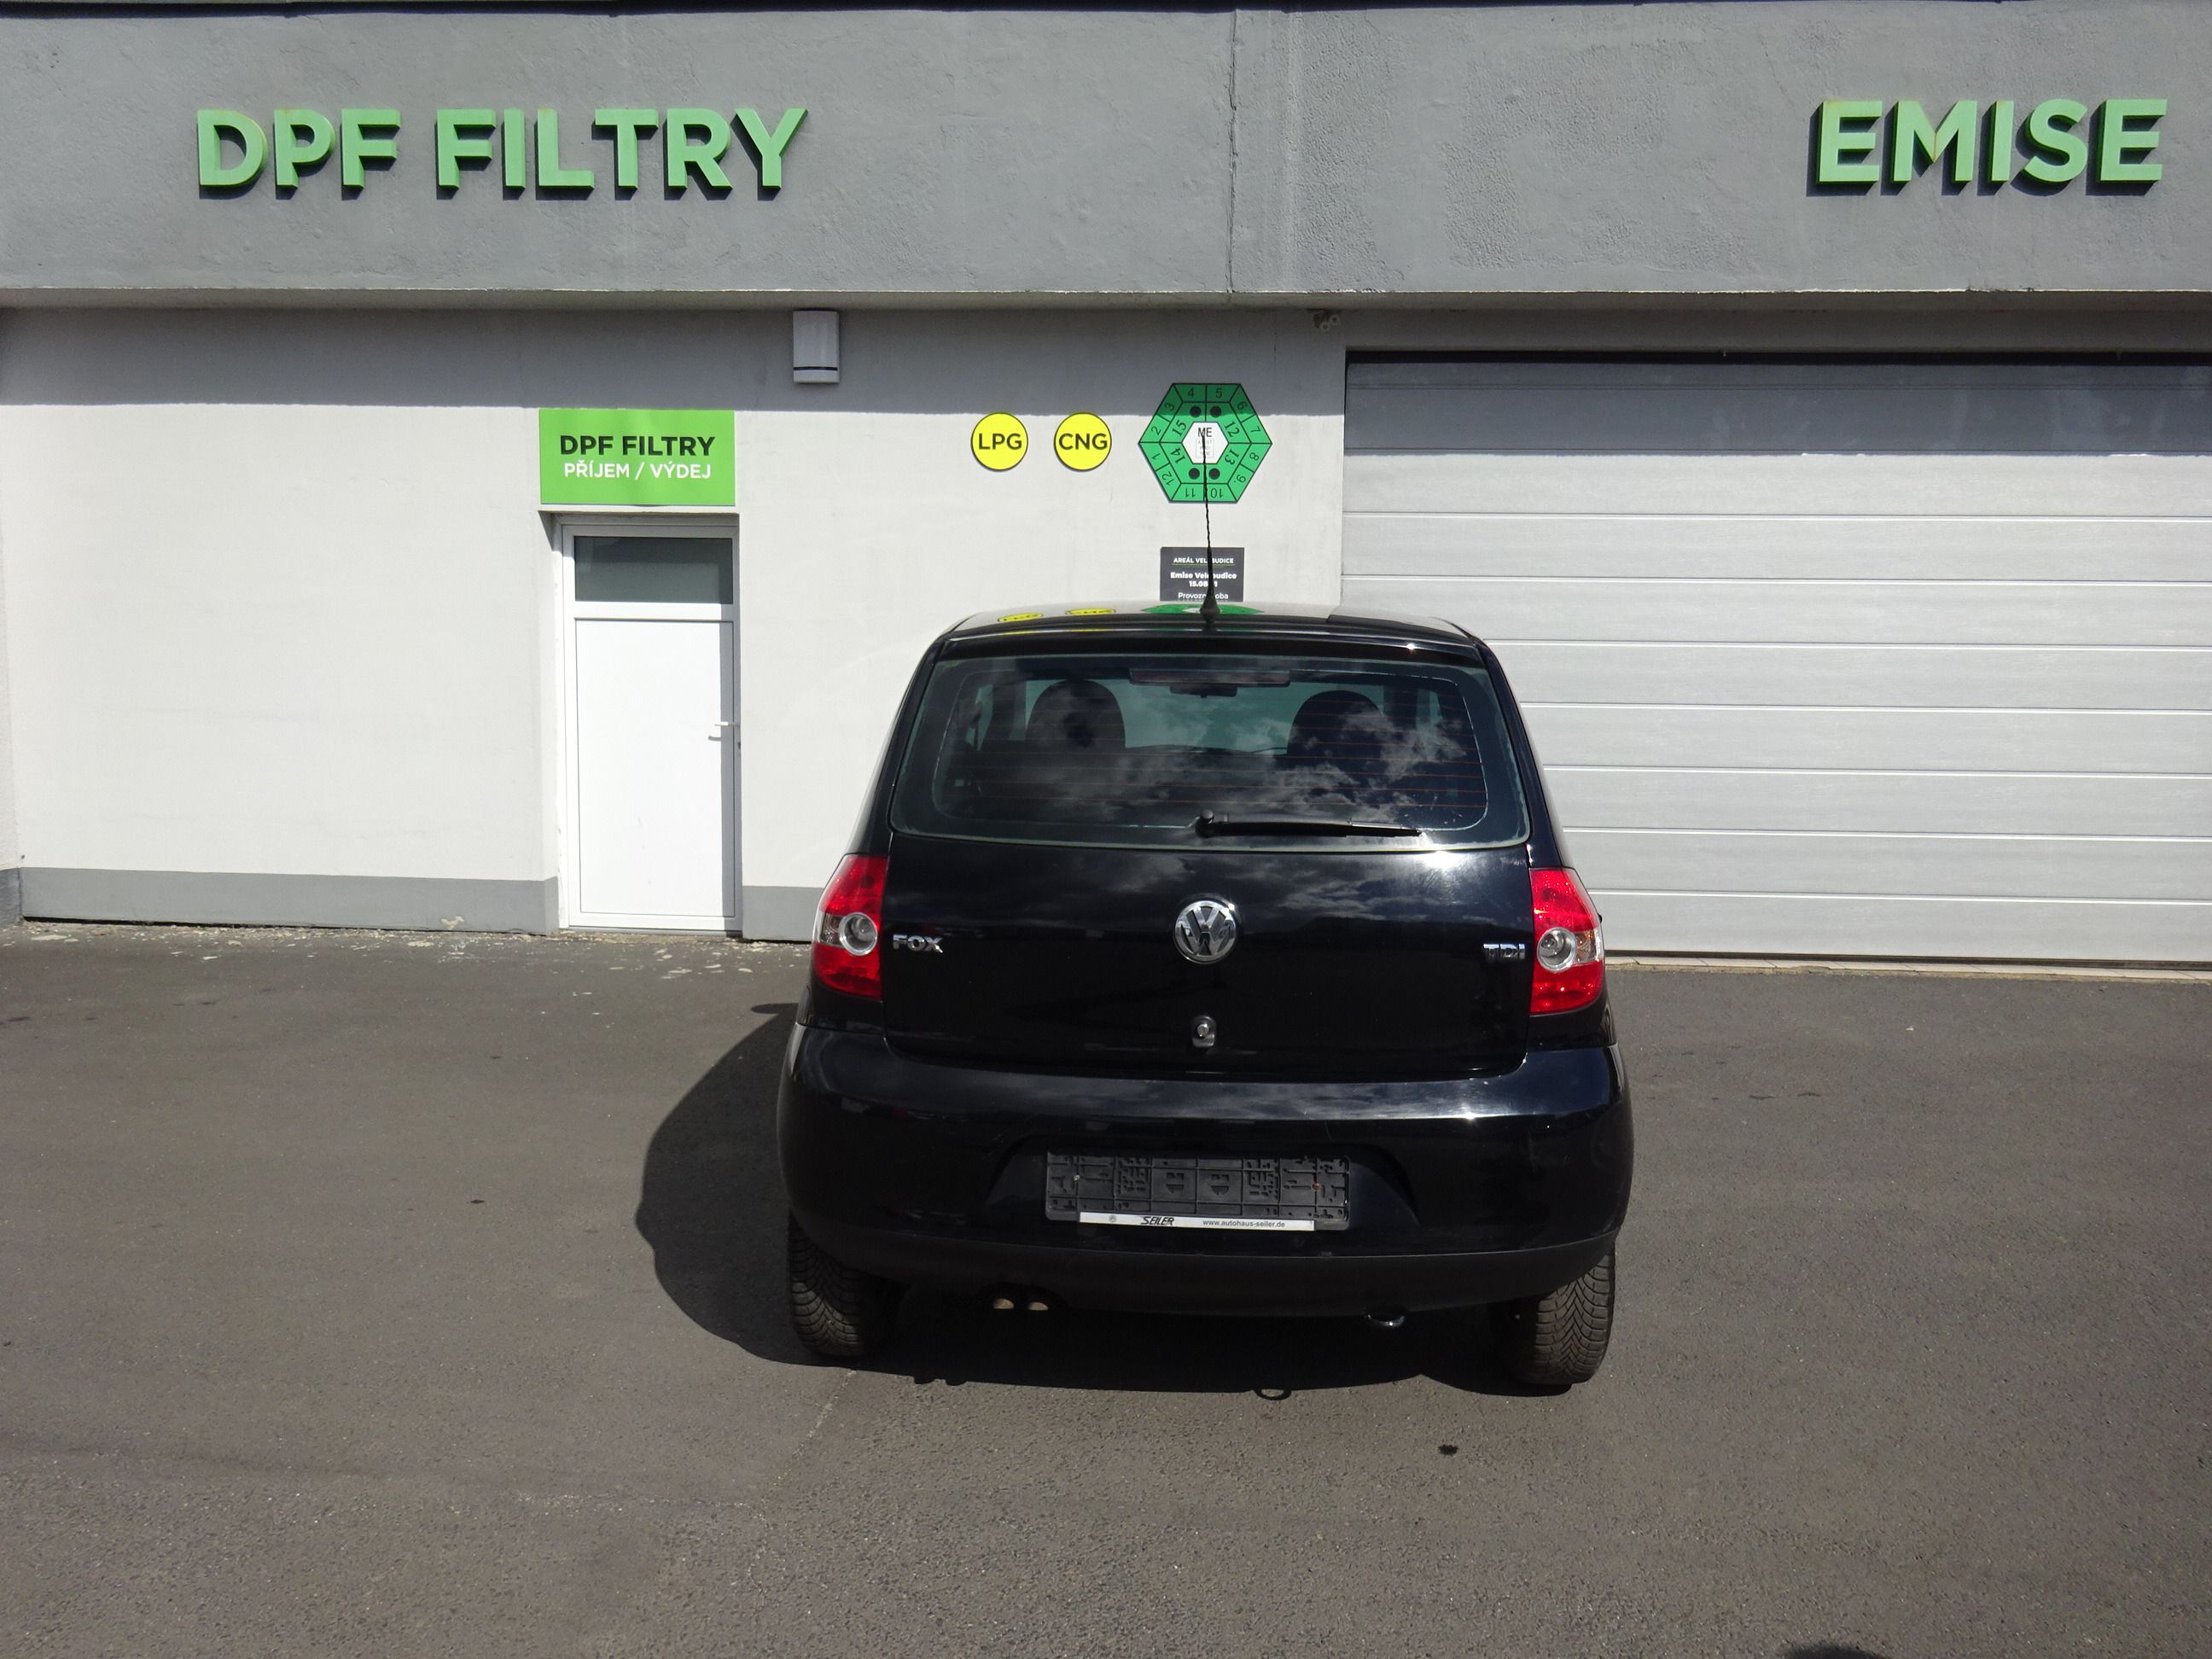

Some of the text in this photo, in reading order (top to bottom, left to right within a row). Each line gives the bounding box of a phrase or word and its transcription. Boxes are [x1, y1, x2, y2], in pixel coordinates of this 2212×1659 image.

[196, 108, 808, 188] DPF FILTRY
[1815, 98, 2168, 185] EMISE
[1187, 387, 1195, 398] 4
[1215, 387, 1223, 399] 5
[1164, 402, 1175, 411] 3
[1151, 426, 1161, 436] 2
[1172, 419, 1187, 436] 15
[1197, 427, 1213, 438] ME
[1224, 422, 1240, 438] 12
[560, 435, 716, 456] DPF FILTRY
[978, 433, 1022, 451] LPG
[1058, 433, 1108, 451] CNG
[1170, 447, 1185, 464] 14
[1225, 449, 1239, 465] 13
[1249, 452, 1260, 462] 8
[564, 459, 711, 480] PŘÍJEM / VÝDEJ
[1161, 471, 1175, 486] 12
[1185, 487, 1196, 498] 11
[1210, 487, 1224, 498] 10
[893, 934, 943, 953] FOX
[1483, 943, 1526, 960] TDI
[1140, 1215, 1286, 1228] SEILER www.autohaus-seiler.de
